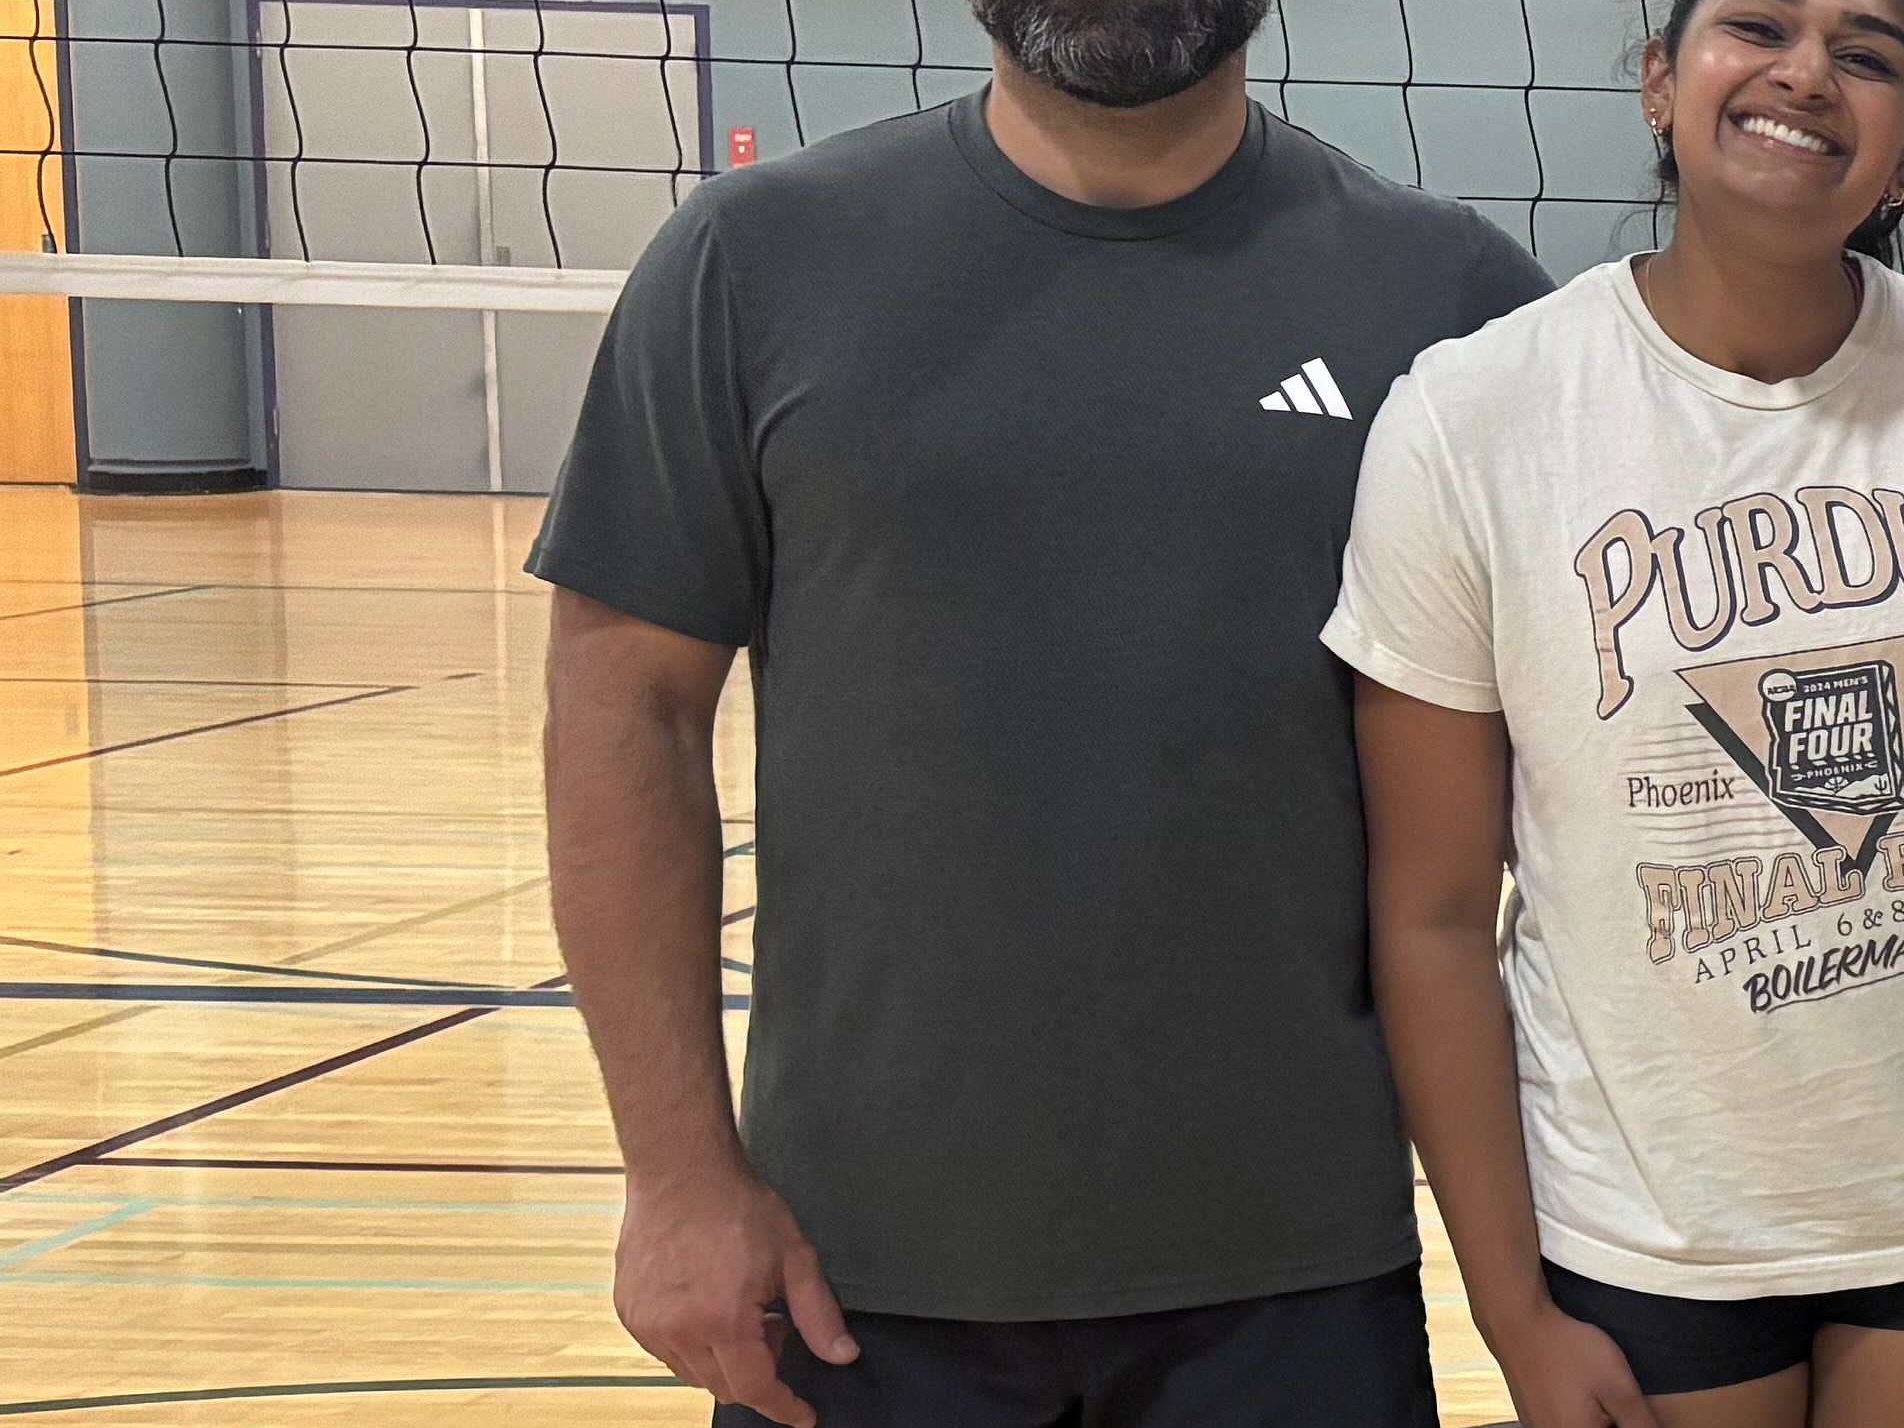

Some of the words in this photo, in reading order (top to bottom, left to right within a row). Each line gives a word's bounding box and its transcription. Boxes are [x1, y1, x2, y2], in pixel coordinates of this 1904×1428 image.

[1785, 690, 1873, 732] FINAL
[1789, 722, 1873, 764] FOUR
[1627, 769, 1735, 808] Phoenix
[1807, 763, 1863, 779] PHOENIX
[1636, 846, 1866, 965] FINAL
[1694, 925, 1812, 983] APRIL
